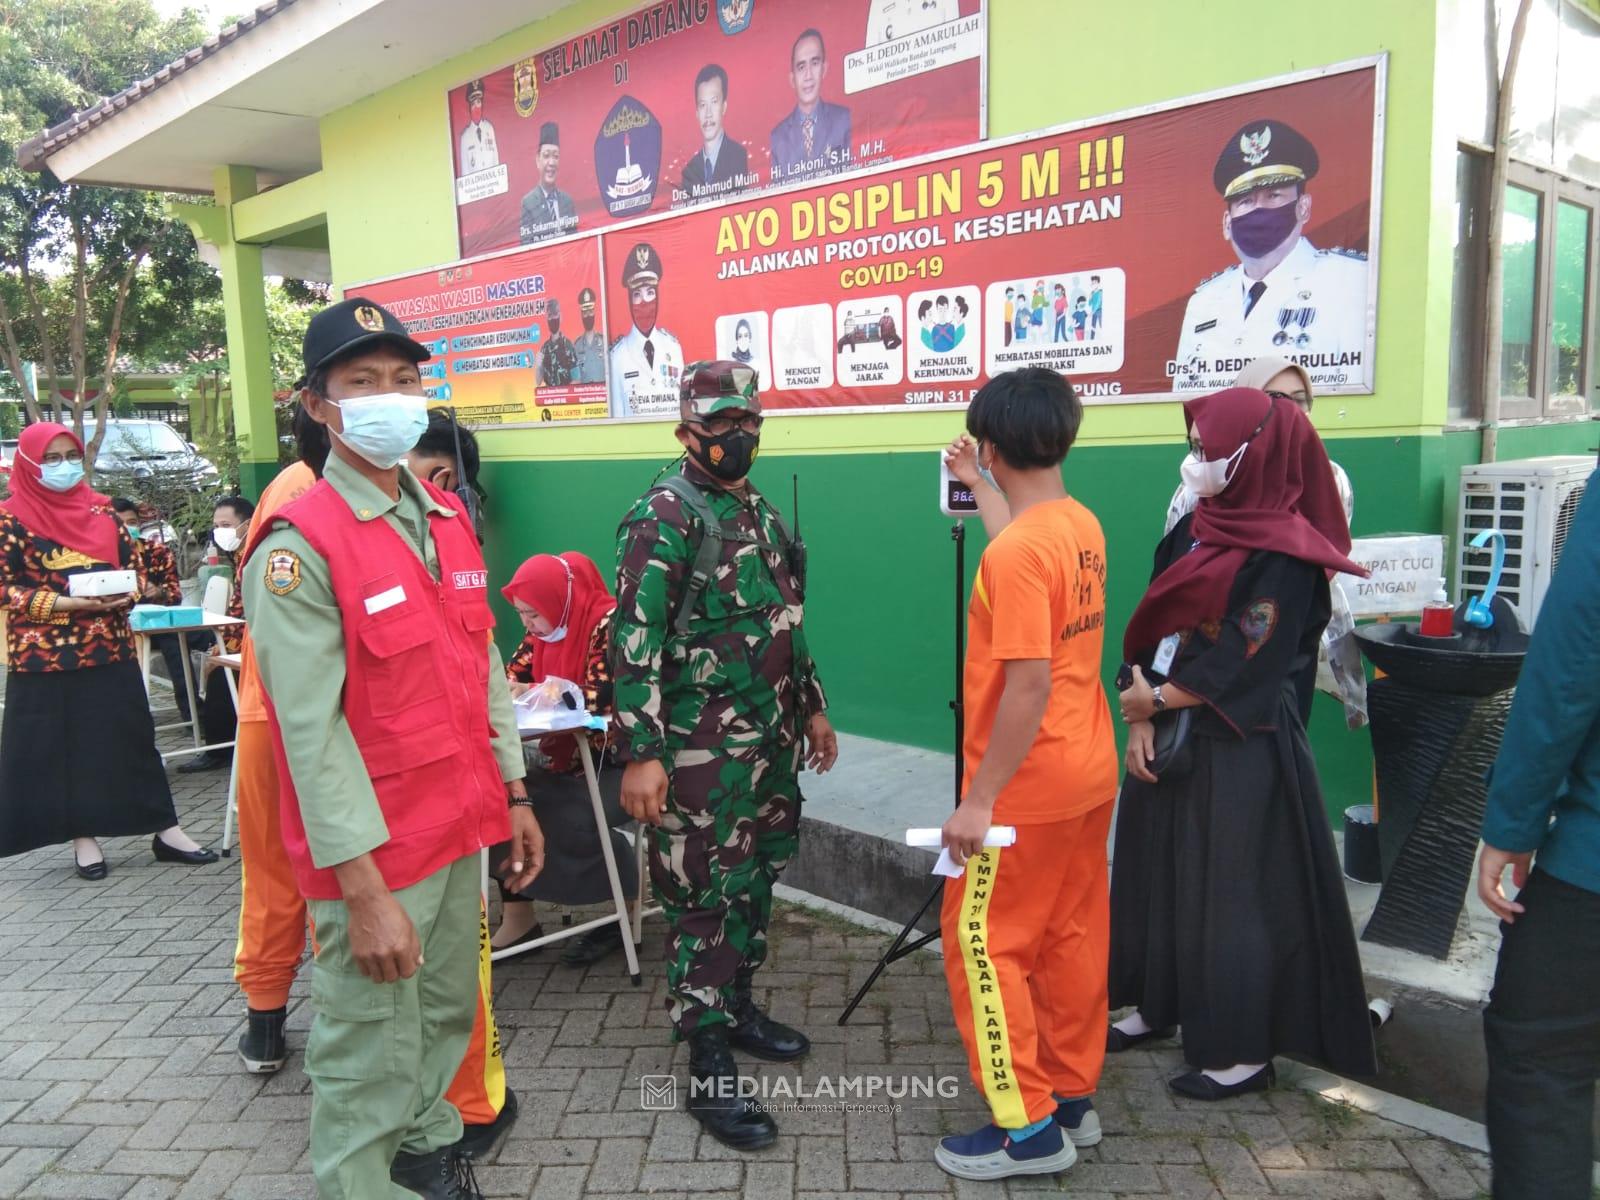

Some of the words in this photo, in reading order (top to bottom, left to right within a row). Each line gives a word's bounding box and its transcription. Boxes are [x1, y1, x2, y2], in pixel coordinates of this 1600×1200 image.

[543, 25, 620, 83] SELAMAT
[627, 0, 709, 50] DATANG
[848, 58, 865, 70] Drs.
[866, 52, 876, 64] H.
[878, 40, 912, 60] DEDDY
[914, 18, 979, 49] AMARULLAH
[868, 63, 884, 74] Wakil
[884, 57, 909, 69] Walikota
[909, 51, 929, 62] Bandar
[930, 42, 957, 55] Lampung
[614, 60, 629, 86] DI
[886, 68, 907, 79] Periode
[787, 155, 827, 176] Lakoni,
[830, 148, 857, 165] S.H.,
[860, 139, 886, 158] M.H.
[672, 189, 690, 202] Drs.
[692, 181, 733, 197] Mahmud
[734, 172, 760, 187] Muin
[715, 208, 780, 255] AYO
[791, 167, 961, 242] DISIPLIN
[978, 159, 1004, 208] 5
[1020, 147, 1060, 201] M
[1078, 134, 1126, 191] !!!
[520, 226, 531, 237] Drs.
[559, 215, 579, 228] Wijaya
[717, 243, 819, 281] JALANKAN
[825, 226, 946, 264] PROTOKOL
[953, 194, 1122, 244] KESEHATAN
[839, 256, 944, 290] COVID-19
[442, 286, 484, 310] WAJIB
[486, 275, 545, 301] MASKER
[464, 306, 490, 325] DENGAN
[491, 302, 534, 321] MENERAPKAN
[460, 335, 496, 348] MENGHINDARI
[496, 330, 531, 344] KERUMUNAN
[461, 358, 491, 372] MEMBATASI
[491, 355, 521, 369] MOBILITAS
[920, 356, 967, 368] MENJAUHI
[995, 350, 1043, 362] MEMBATASI
[1044, 347, 1091, 360] MOBILITAS
[1092, 344, 1113, 356] DAN
[1168, 362, 1194, 376] Drs.
[1198, 361, 1211, 374] H.
[1286, 351, 1362, 368] ARULLAH
[785, 366, 821, 377] MENCUCI
[850, 362, 889, 372] MENJAGA
[914, 366, 974, 379] KERUMUNAN
[1028, 359, 1075, 370] INTERAKSI
[786, 376, 820, 386] TANGAN
[855, 372, 884, 382] JARAK
[1311, 374, 1348, 384] MPUNG)
[638, 395, 650, 405] EVA
[905, 390, 944, 404] SMPN
[948, 389, 964, 402] 31
[1072, 381, 1122, 397] PUNG
[1358, 559, 1398, 572] MPAT
[1401, 557, 1434, 570] CUCI
[1356, 581, 1417, 596] TANGAN
[973, 852, 992, 900] SMPN
[970, 904, 984, 917] 31
[968, 921, 993, 994] BANDAR
[984, 1004, 1011, 1092] LAMPUNG
